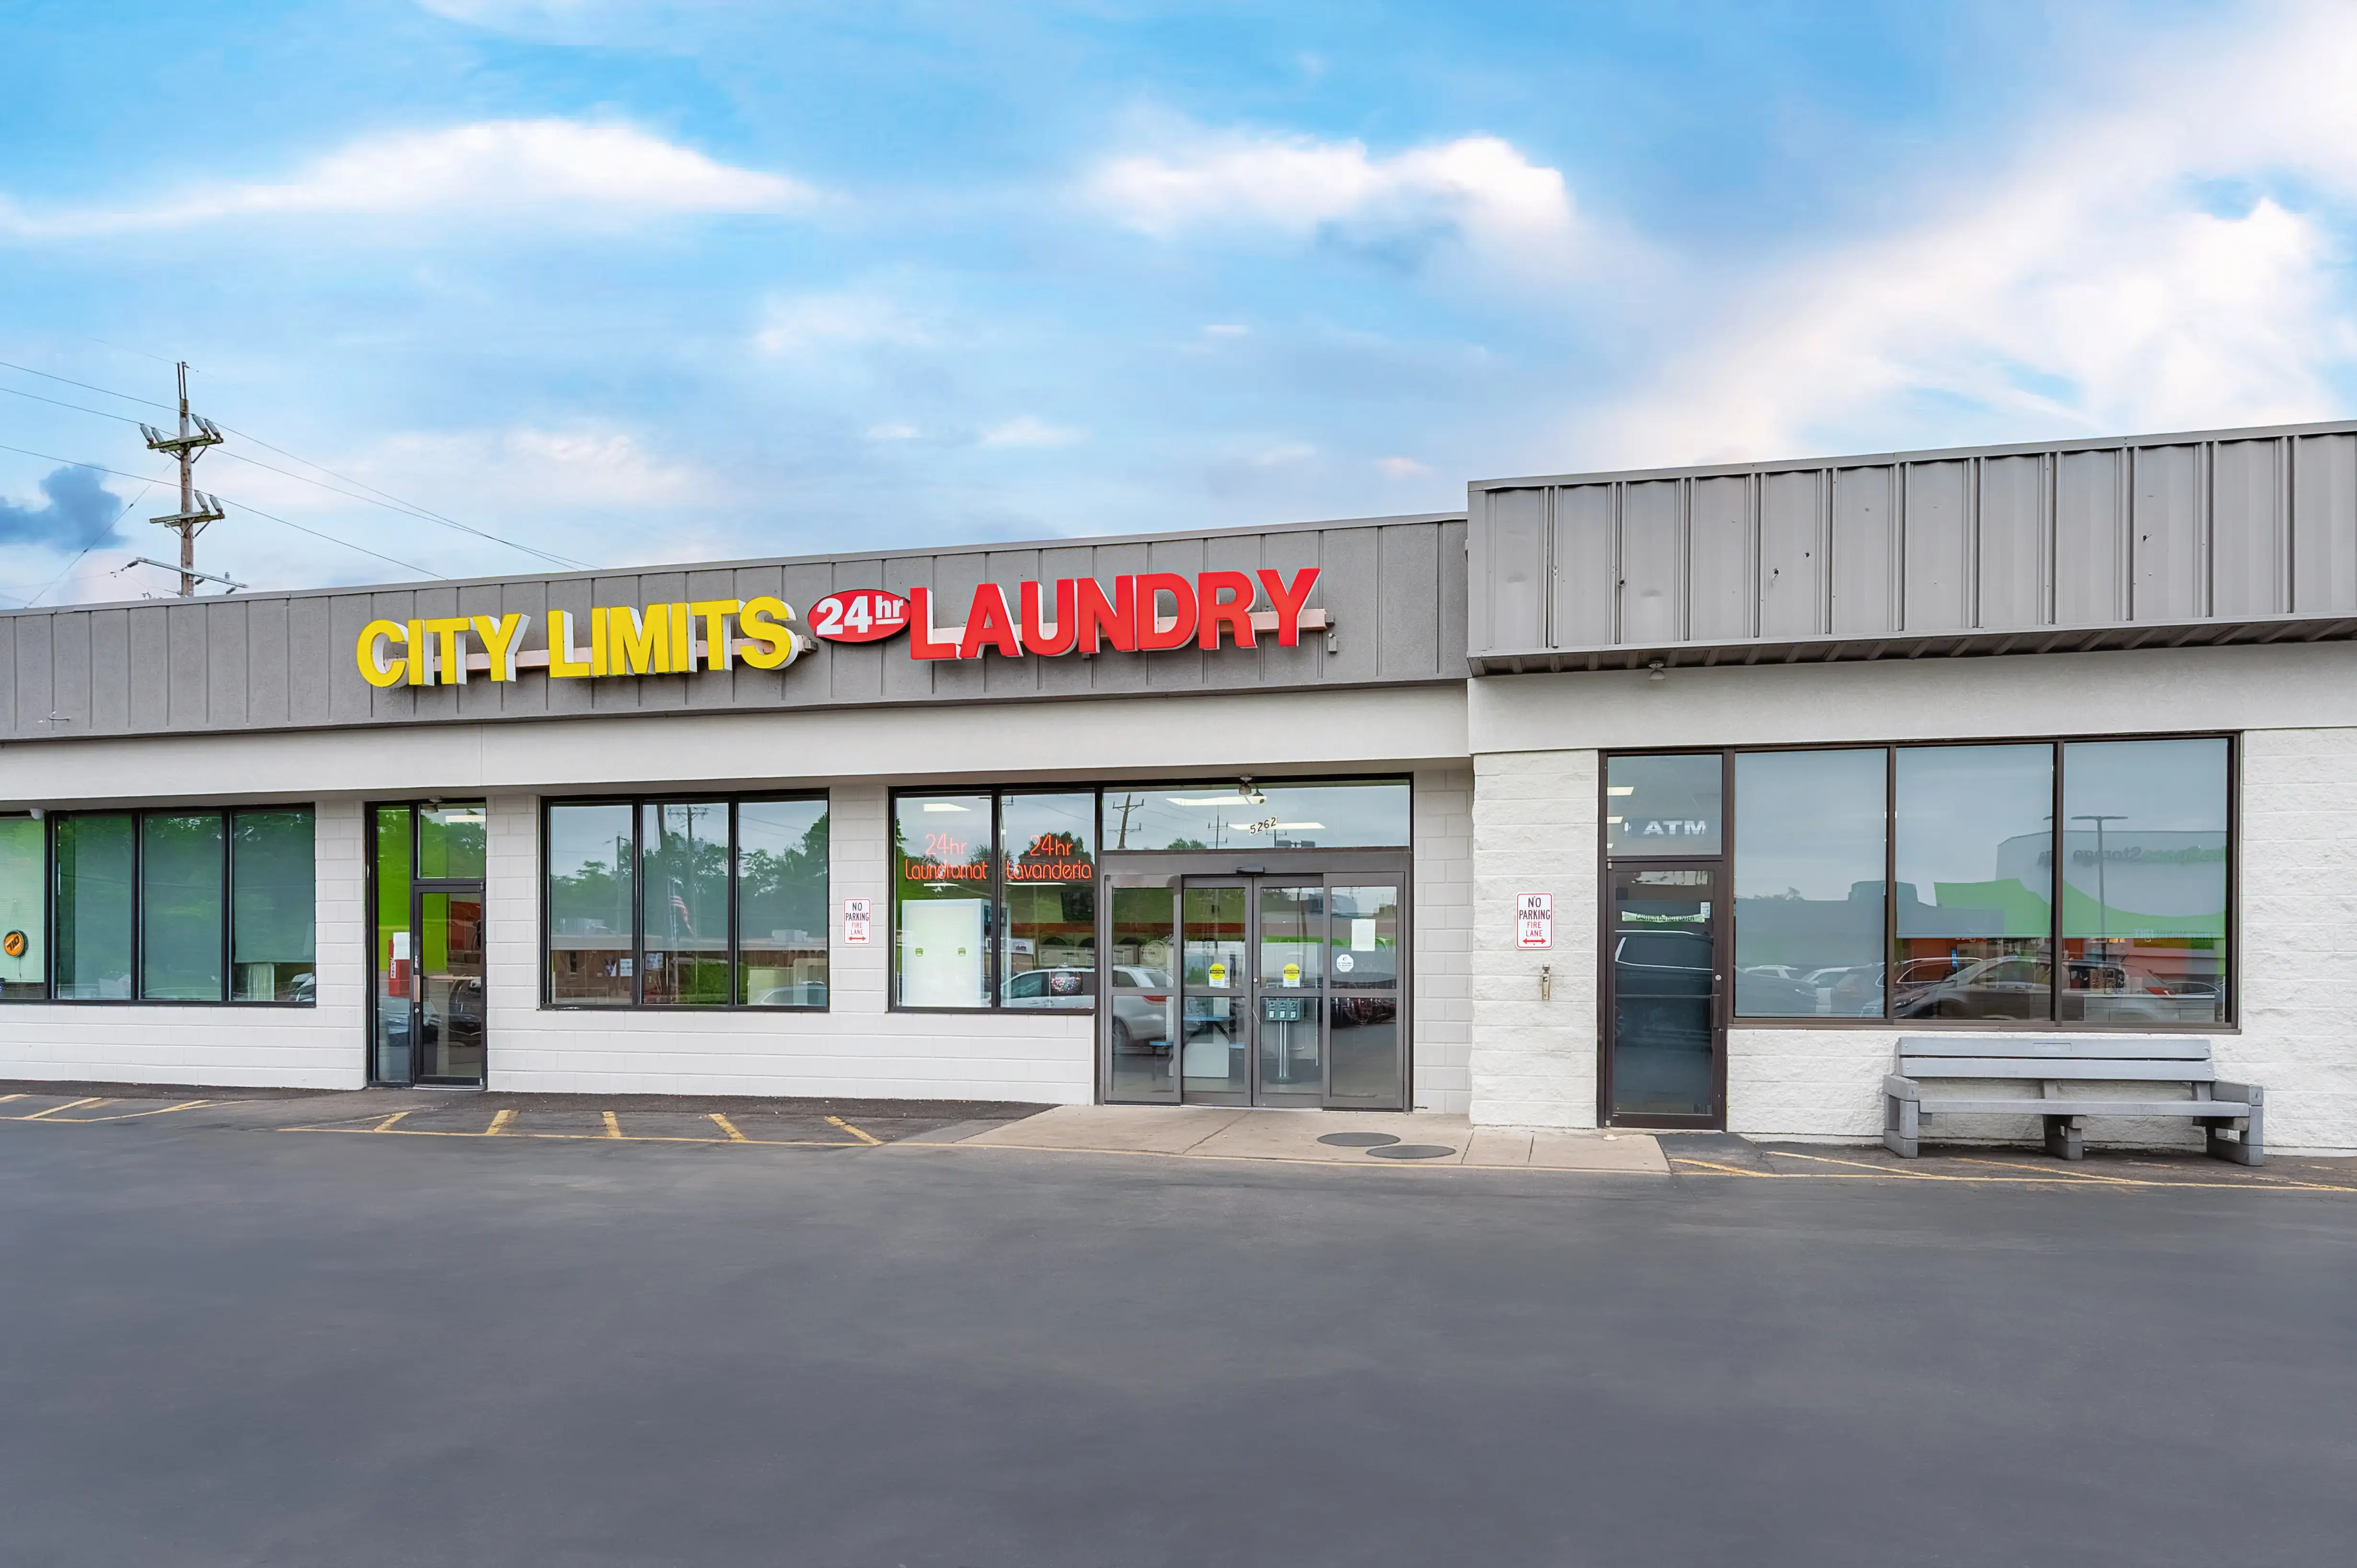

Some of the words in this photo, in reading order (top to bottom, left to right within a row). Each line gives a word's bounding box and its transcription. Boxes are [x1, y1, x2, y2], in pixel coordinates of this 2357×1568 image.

[356, 613, 527, 688] CITY
[548, 596, 795, 678] LIMITS
[815, 595, 904, 637] 24hr
[909, 568, 1321, 661] LAUNDRY
[1250, 817, 1276, 834] 5262
[1643, 820, 1705, 835] ATM
[925, 833, 967, 856] 24hr
[1030, 834, 1073, 857] 24hr
[905, 859, 988, 880] Laundromat
[1007, 860, 1092, 880] Lavanderia
[852, 903, 862, 911] NO
[1528, 897, 1541, 907] NO
[846, 913, 869, 921] PARKING
[1519, 910, 1550, 920] PARKING
